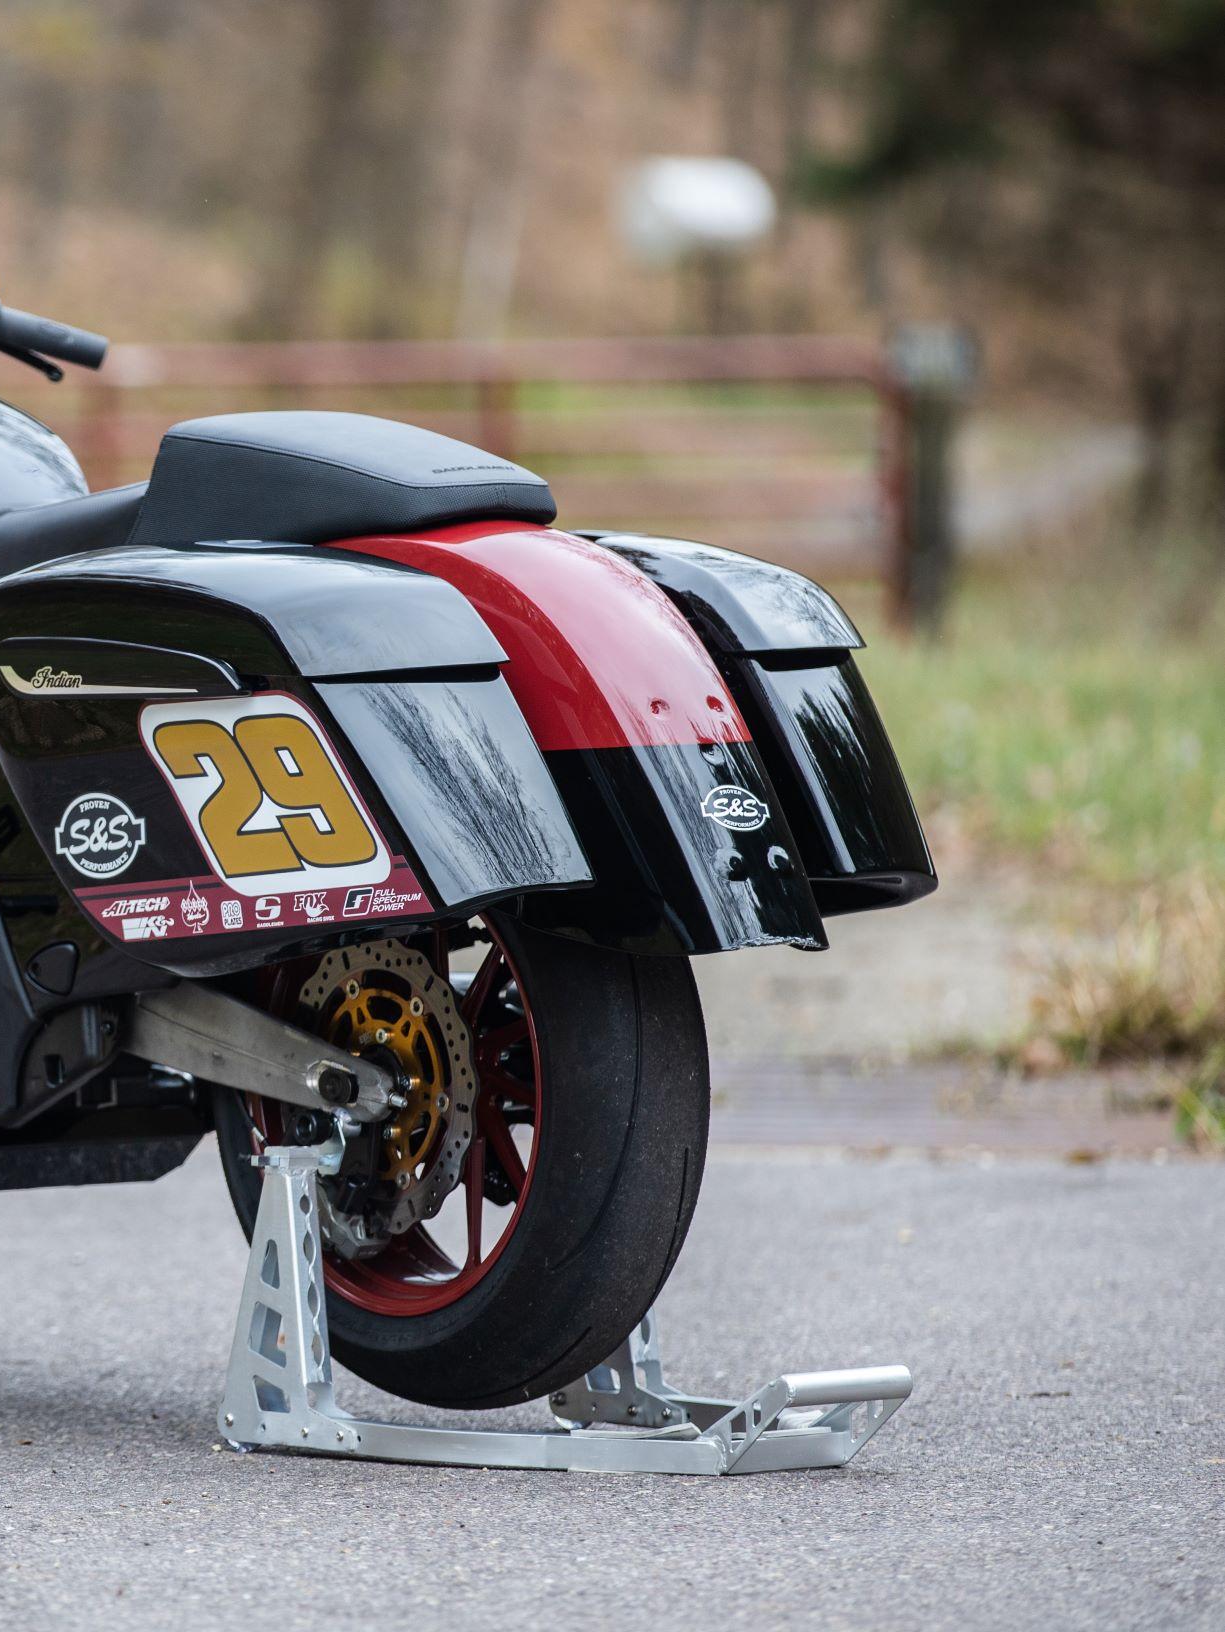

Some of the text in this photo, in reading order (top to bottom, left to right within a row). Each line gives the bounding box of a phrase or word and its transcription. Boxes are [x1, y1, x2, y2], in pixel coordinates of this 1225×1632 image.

[32, 667, 82, 688] Indian
[153, 713, 378, 879] 29
[79, 801, 110, 812] PROVEN
[713, 798, 759, 818] S&S
[69, 814, 130, 855] S&S
[79, 851, 130, 872] PERFORMANCE
[293, 891, 327, 912] FOX
[373, 892, 422, 905] SPECTRUM
[374, 888, 396, 898] FULL
[223, 902, 241, 918] PRO
[371, 902, 405, 913] POWER
[224, 916, 242, 926] PLATES
